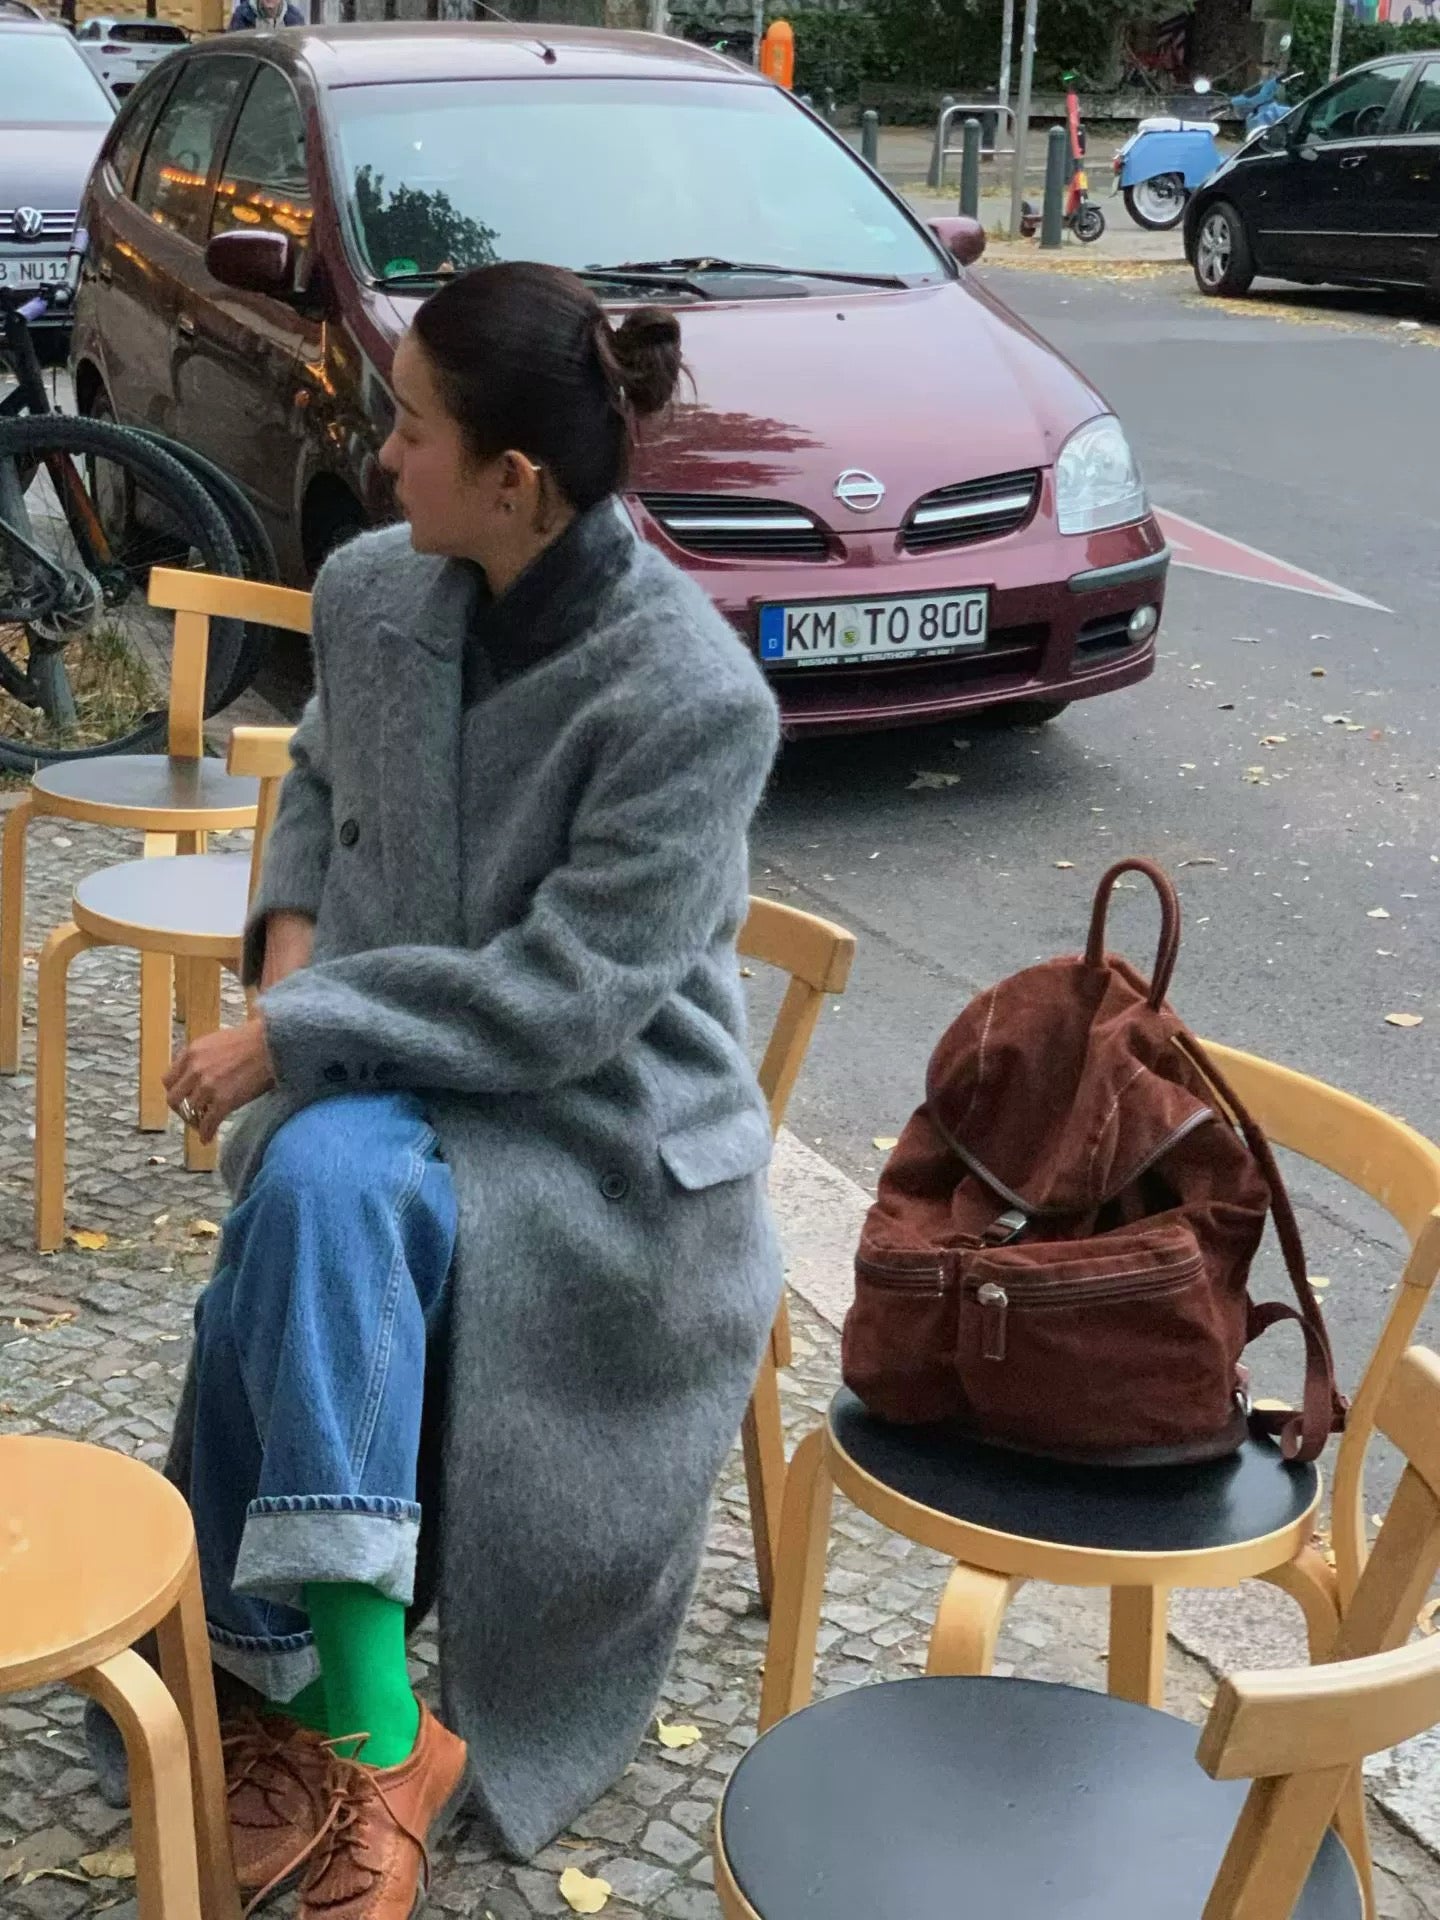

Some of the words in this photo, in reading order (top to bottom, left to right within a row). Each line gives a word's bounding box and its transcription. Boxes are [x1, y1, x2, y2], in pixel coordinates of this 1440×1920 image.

[20, 262, 44, 280] NU
[786, 611, 835, 651] KM
[864, 606, 909, 645] TO
[919, 599, 983, 641] 800
